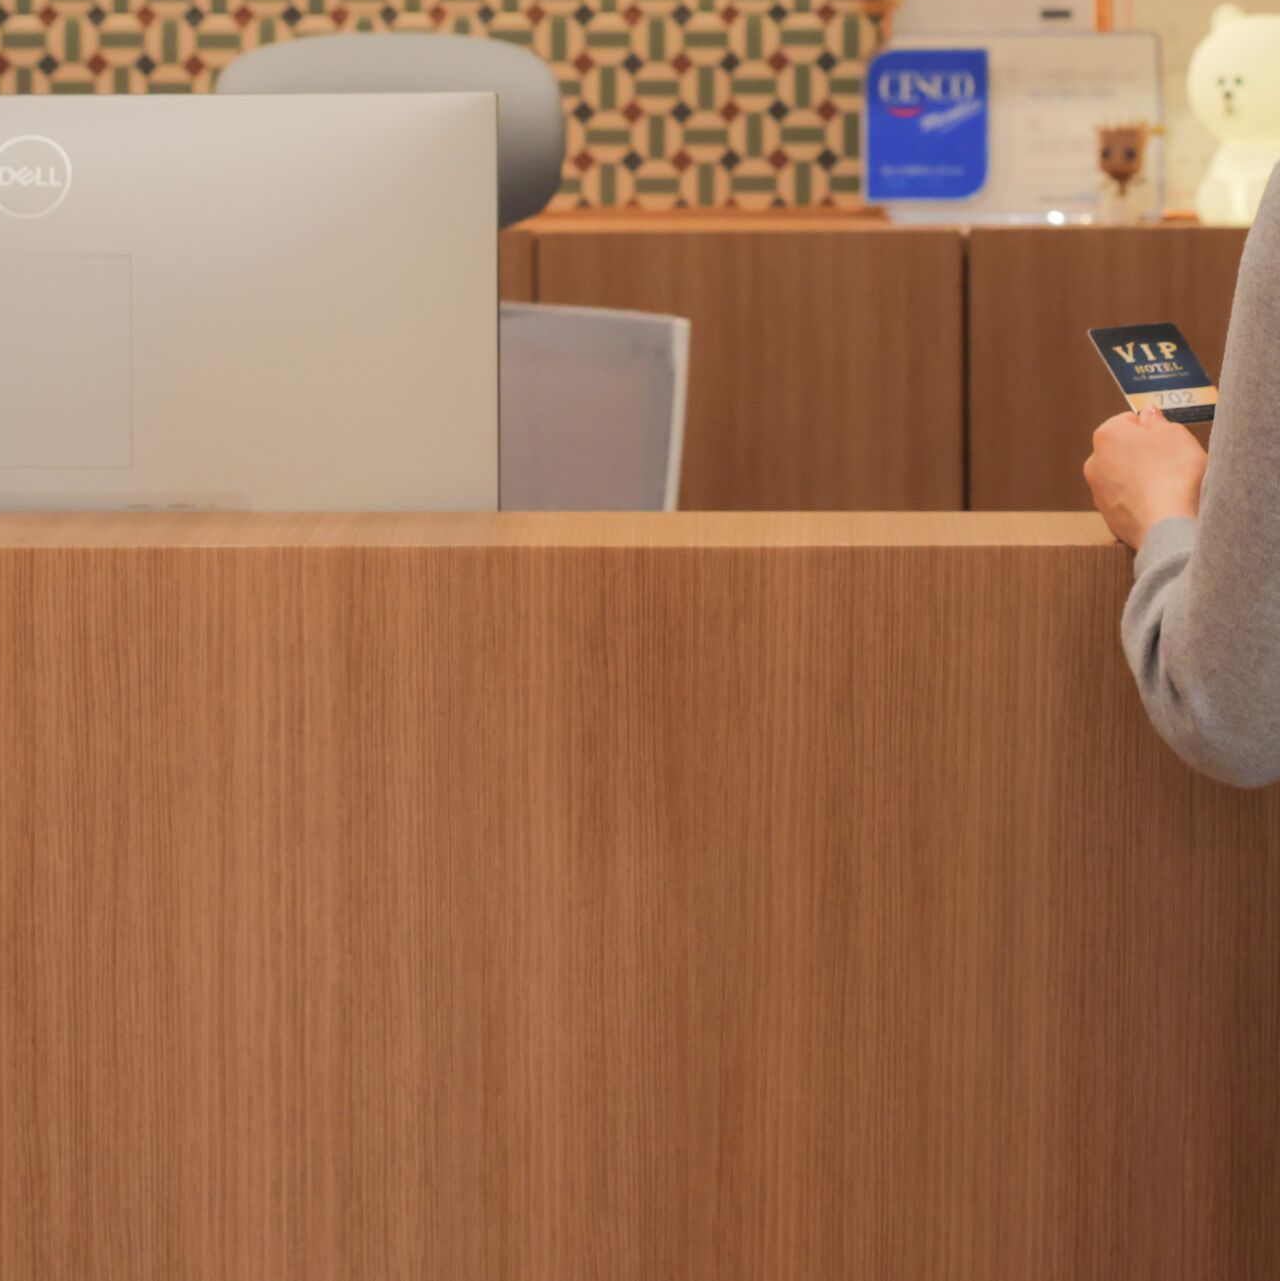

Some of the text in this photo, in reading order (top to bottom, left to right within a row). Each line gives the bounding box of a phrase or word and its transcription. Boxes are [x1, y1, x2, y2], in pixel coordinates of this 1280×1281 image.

[1111, 340, 1178, 364] VIP
[1134, 361, 1184, 374] HOTEL
[1154, 390, 1198, 406] 702
